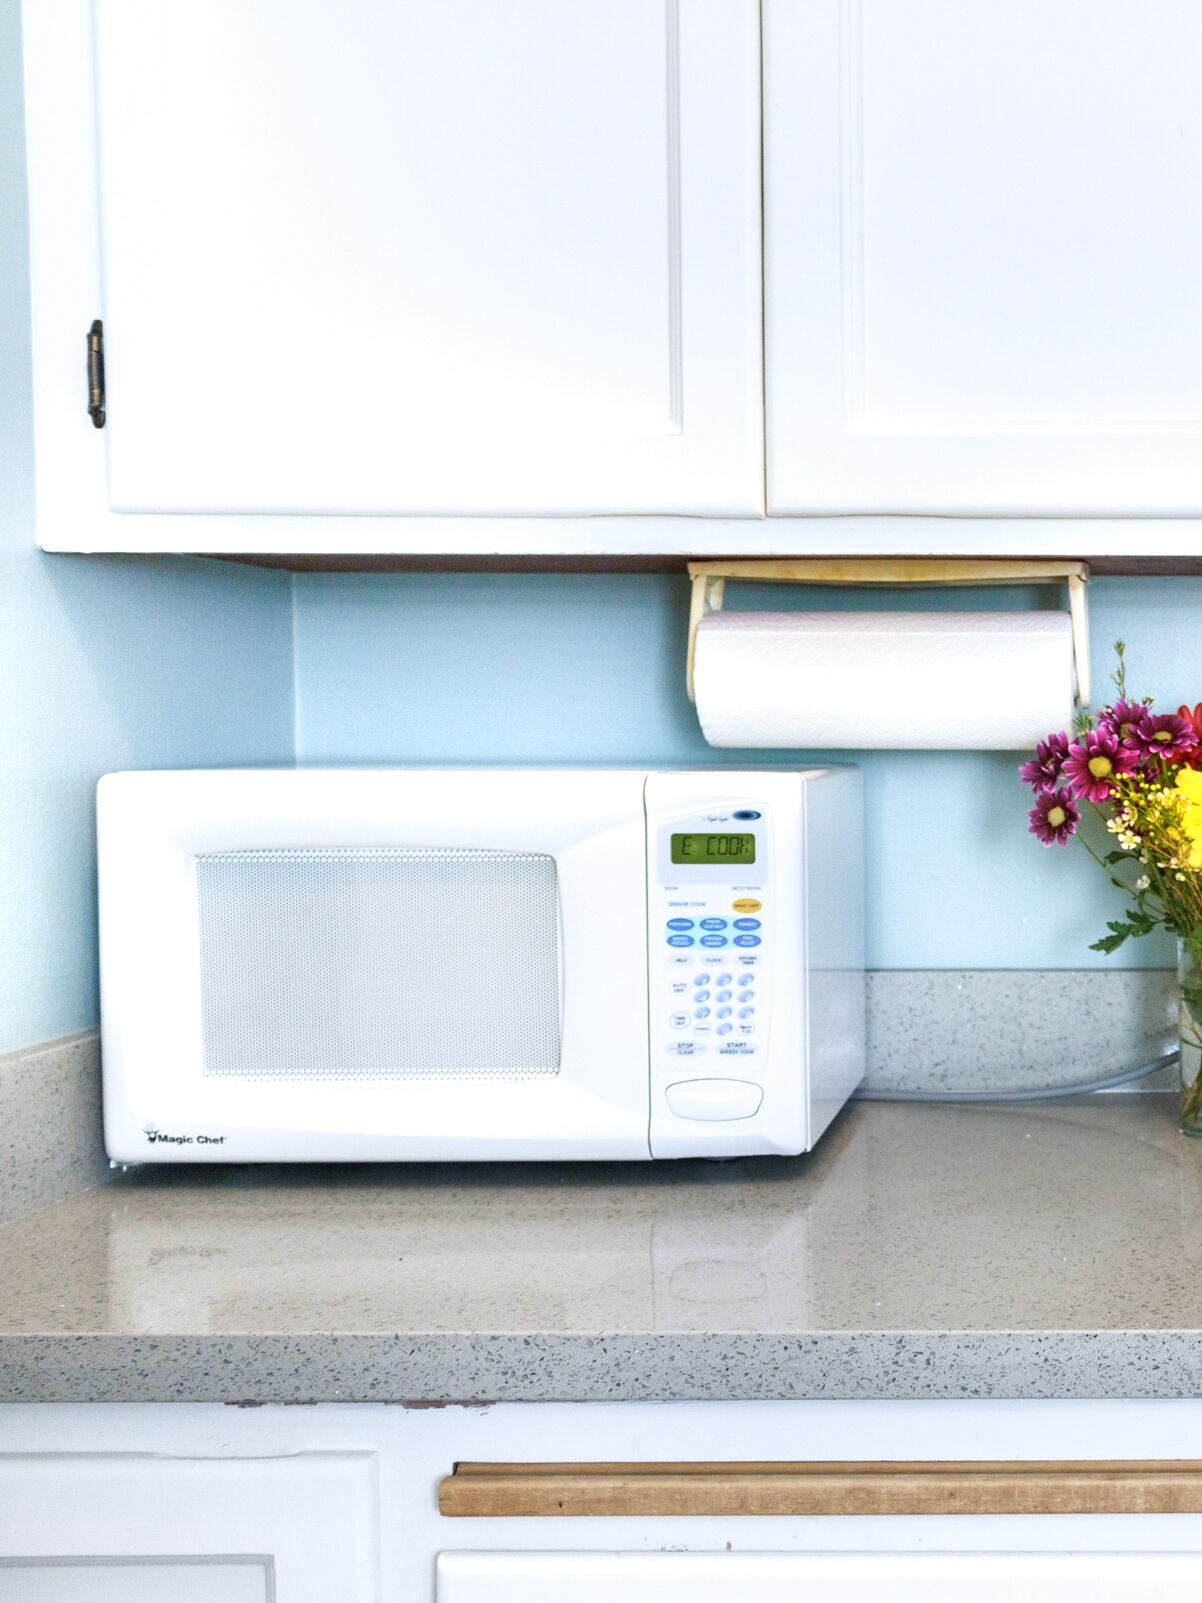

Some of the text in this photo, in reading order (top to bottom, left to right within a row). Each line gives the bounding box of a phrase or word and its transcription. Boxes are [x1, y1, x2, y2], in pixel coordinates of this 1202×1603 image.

[706, 836, 750, 856] COOK
[157, 1134, 224, 1145] Magic Chef
